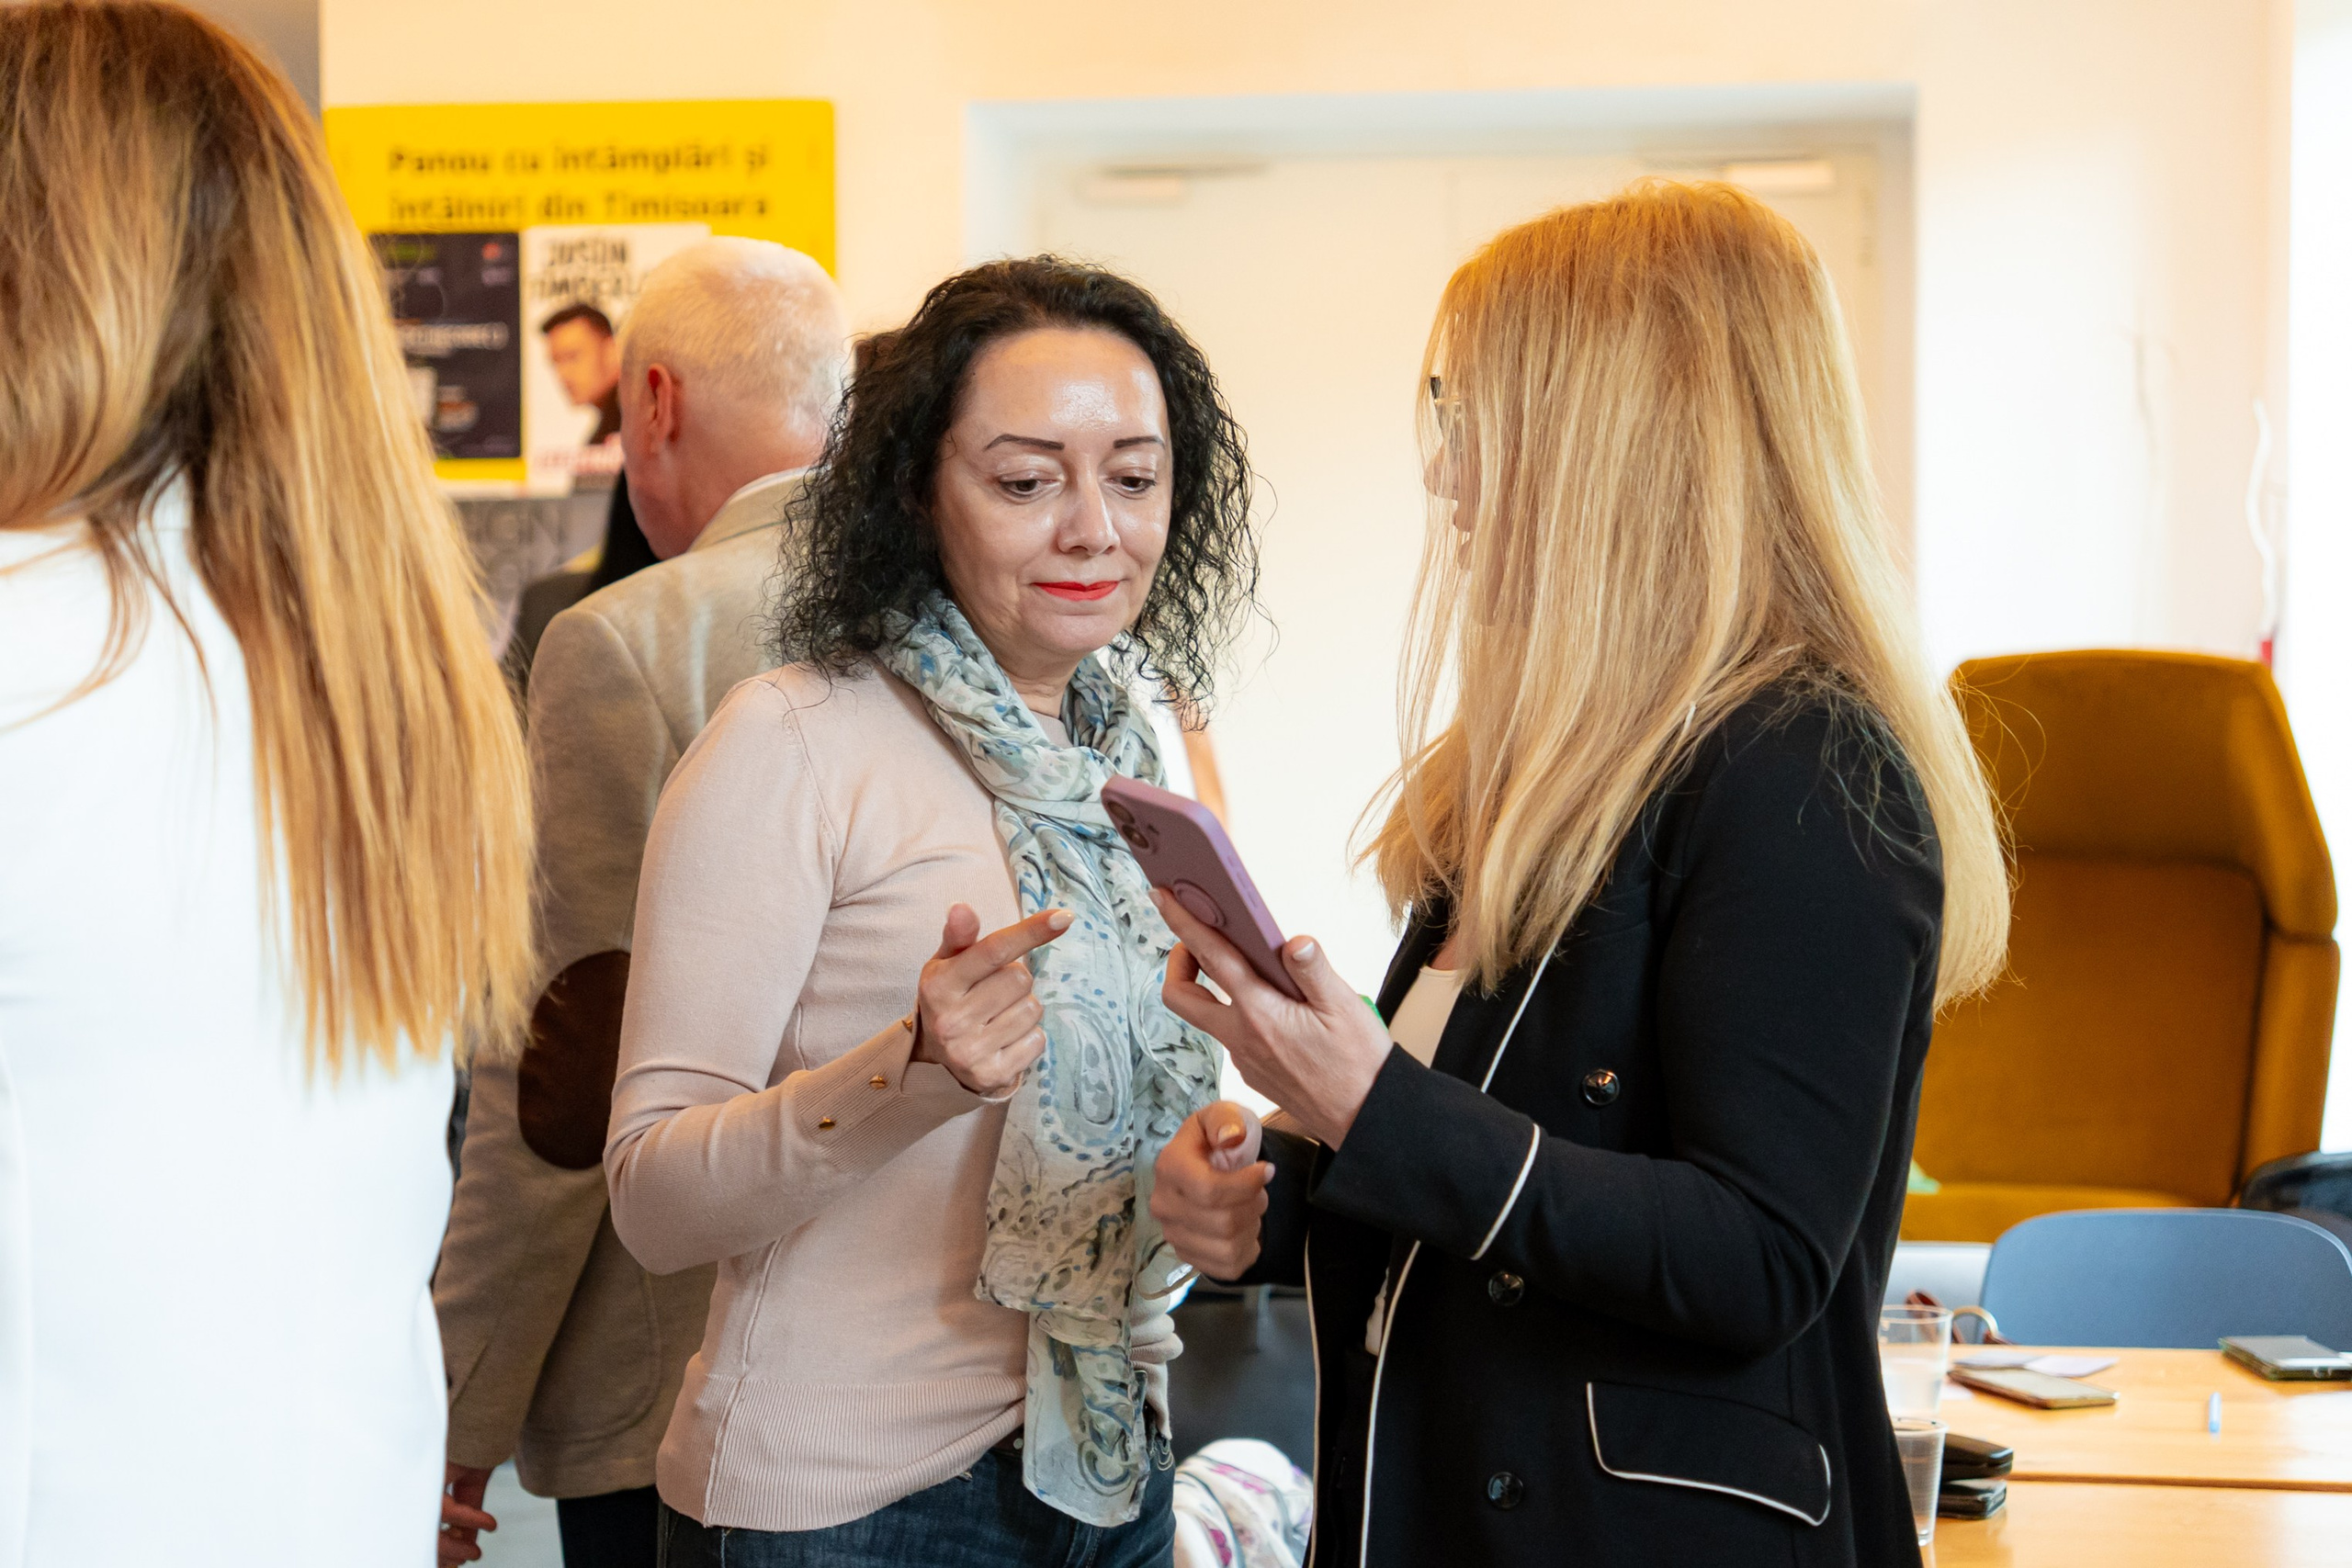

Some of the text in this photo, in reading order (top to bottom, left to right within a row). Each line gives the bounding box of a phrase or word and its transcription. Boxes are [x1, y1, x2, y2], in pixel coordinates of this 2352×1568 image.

[386, 145, 491, 171] Panou
[503, 150, 540, 172] cu
[538, 192, 586, 218] din
